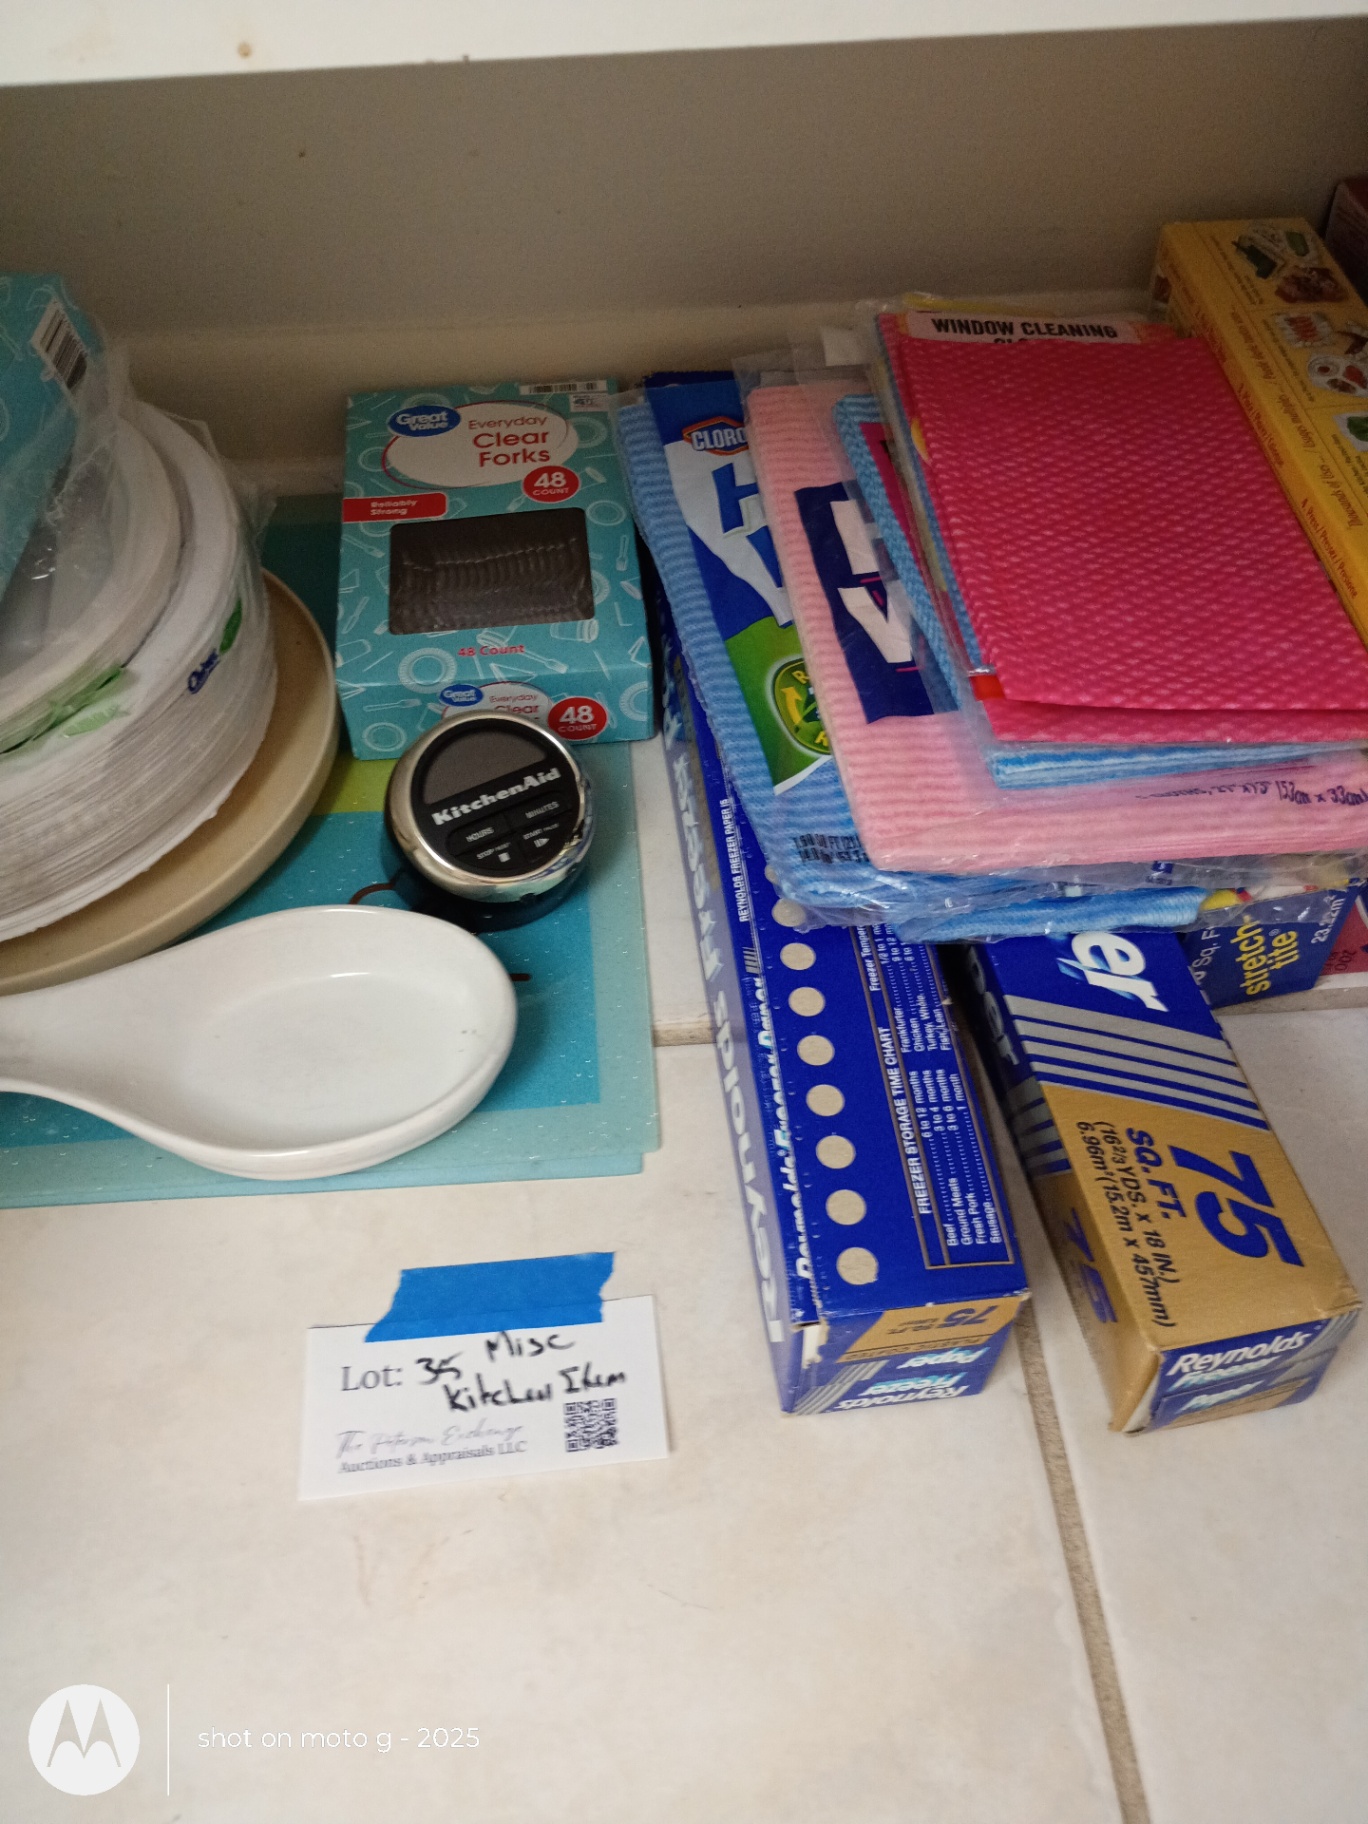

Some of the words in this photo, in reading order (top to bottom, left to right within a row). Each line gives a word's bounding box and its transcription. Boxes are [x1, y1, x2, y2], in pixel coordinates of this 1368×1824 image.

[931, 317, 1014, 336] WINDOW
[1022, 322, 1118, 339] CLEANING
[396, 411, 448, 426] Great
[409, 421, 449, 431] Value
[468, 416, 547, 430] Everyday
[473, 432, 549, 448] Clear
[691, 427, 746, 451] CLORO
[479, 448, 550, 468] Forks
[533, 471, 567, 489] 48
[533, 487, 569, 496] COUNT
[458, 647, 475, 657] 48
[480, 644, 525, 655] Count
[558, 724, 597, 733] COUNT
[559, 705, 594, 724] 48
[431, 767, 562, 826] KitchenAid
[721, 810, 736, 835] PAPER
[726, 838, 742, 874] FREEZER
[733, 876, 750, 922] REYNOLDS
[1192, 942, 1222, 972] Sq.
[865, 959, 881, 991] Freezer
[916, 993, 931, 1020] Whole
[894, 1007, 912, 1053] Frankfurter
[910, 1018, 925, 1052] Chicken
[878, 1027, 897, 1065] CHART
[887, 1068, 904, 1096] TIME
[909, 1070, 925, 1103] months
[922, 1069, 938, 1103] months
[936, 1069, 951, 1102] months
[949, 1073, 965, 1101] month
[894, 1099, 918, 1154] STORAGE
[711, 989, 785, 1343] Reynolds
[1126, 1127, 1164, 1173] SQ.
[1147, 1179, 1187, 1220] FT.
[907, 1158, 932, 1214] FREEZER
[948, 1178, 964, 1207] Meats
[1119, 1166, 1147, 1208] YDS.
[965, 1193, 980, 1215] Pork
[1137, 1212, 1152, 1224] x
[1167, 1145, 1305, 1268] 75
[943, 1224, 959, 1247] Beef
[954, 1209, 973, 1245] Ground
[971, 1217, 987, 1244] Fresh
[983, 1202, 1002, 1243] Sausage
[1143, 1230, 1167, 1249] 18
[1151, 1251, 1181, 1283] IN.)
[1124, 1237, 1140, 1249] x
[1132, 1253, 1178, 1328] 457mm)
[937, 1304, 998, 1329] 75
[485, 1330, 576, 1362] Misc
[896, 1346, 990, 1369] Paper
[1166, 1331, 1312, 1376] Reynolds
[341, 1366, 402, 1392] Lot:
[415, 1351, 463, 1385] 35
[443, 1372, 552, 1412] Kitchen
[834, 1385, 970, 1409] Reynolds
[858, 1371, 968, 1396] Freezer
[338, 1457, 401, 1474] Auctions
[406, 1453, 416, 1465] &
[421, 1445, 495, 1467] Appraisals
[498, 1440, 528, 1456] LLC
